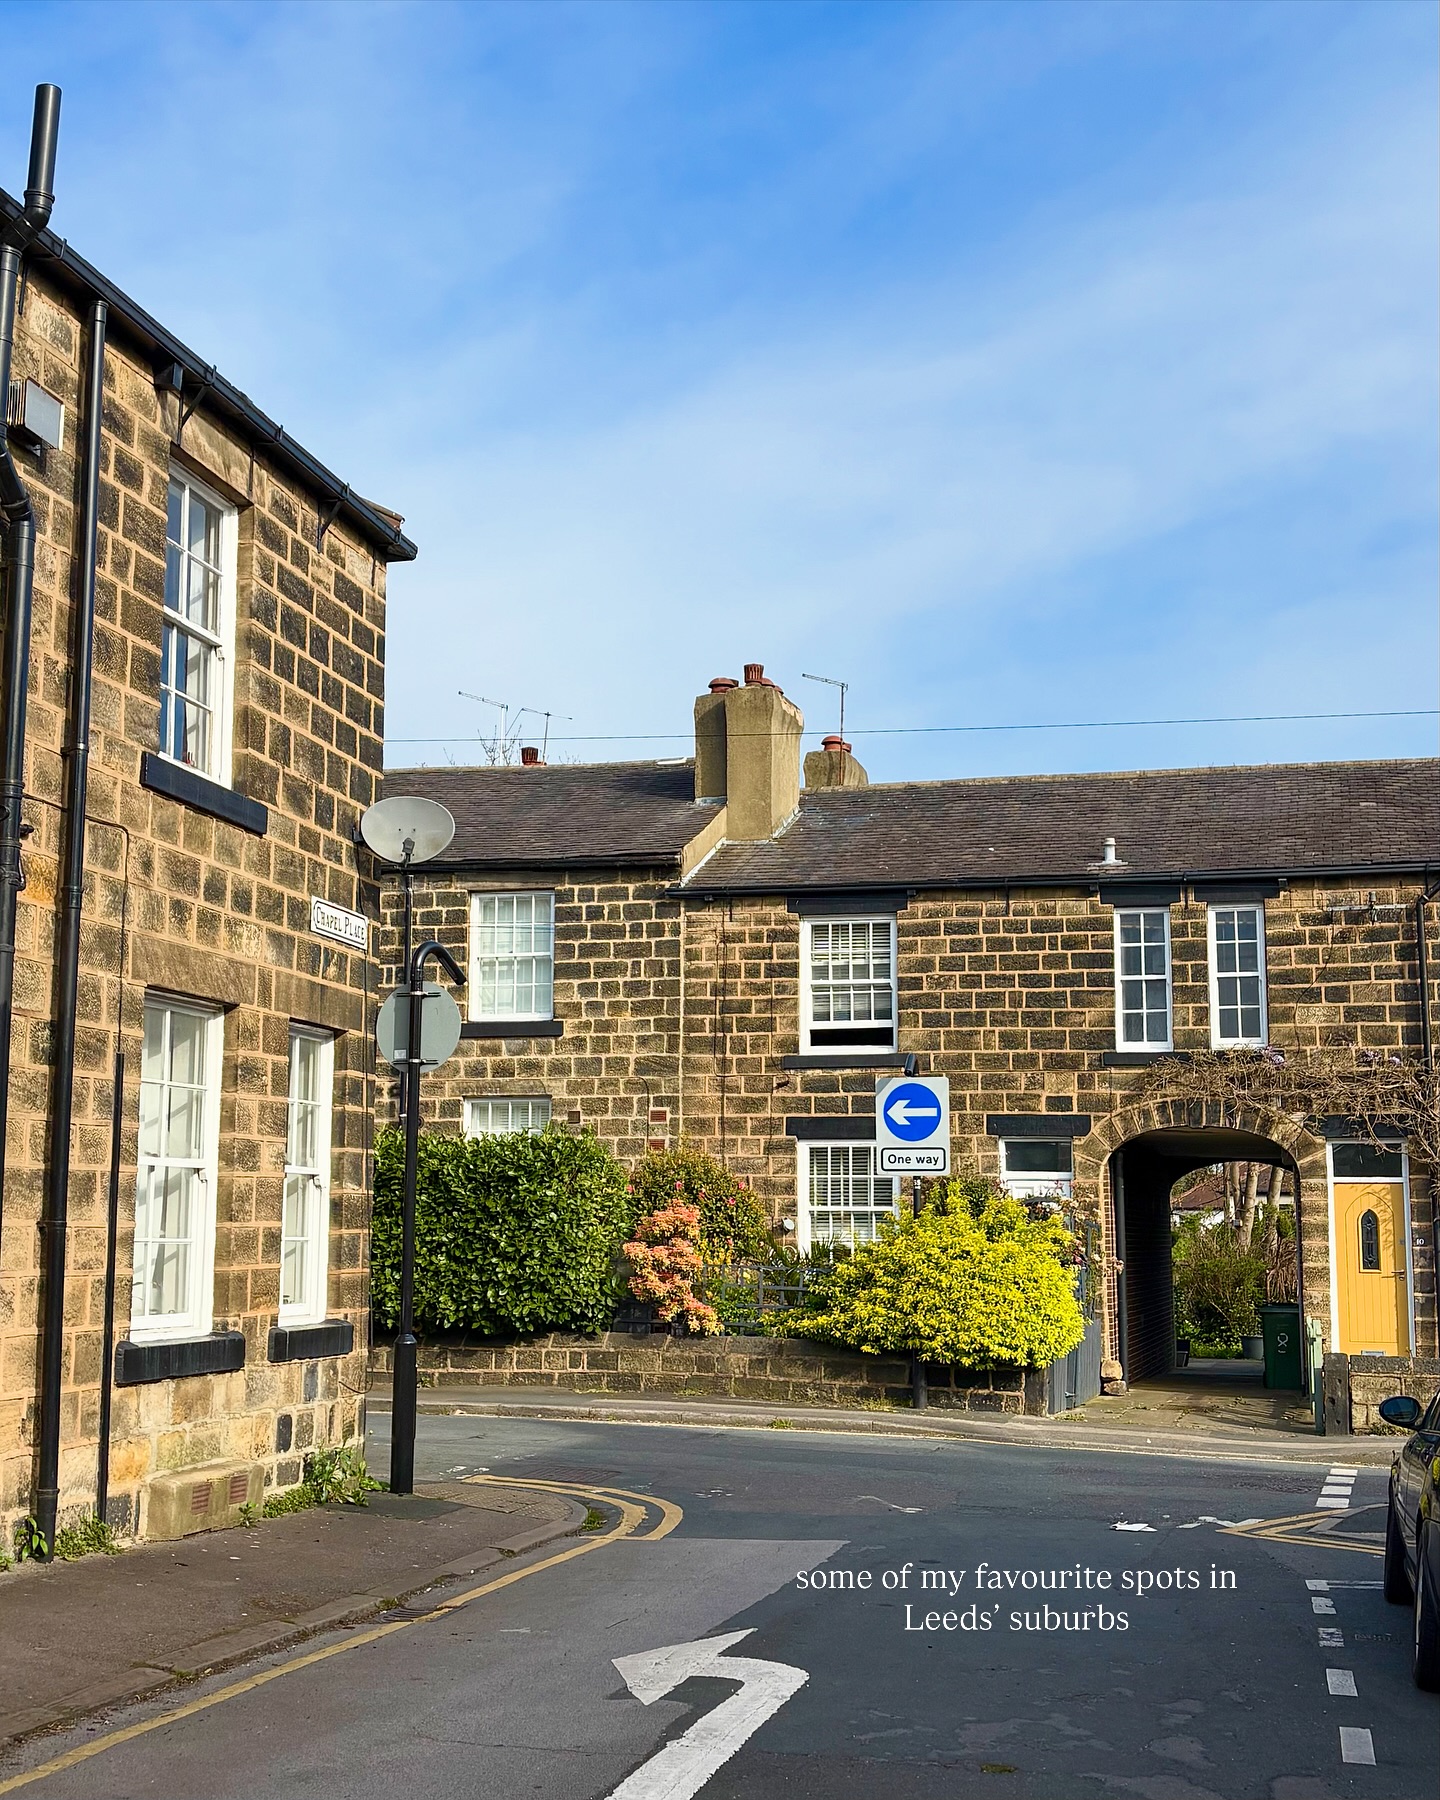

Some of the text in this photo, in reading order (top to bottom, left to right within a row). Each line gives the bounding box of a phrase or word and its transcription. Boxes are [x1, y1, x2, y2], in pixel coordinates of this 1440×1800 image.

[316, 905, 365, 940] CHAPEL PLACE
[887, 1153, 939, 1166] One way
[1416, 1238, 1425, 1246] 10
